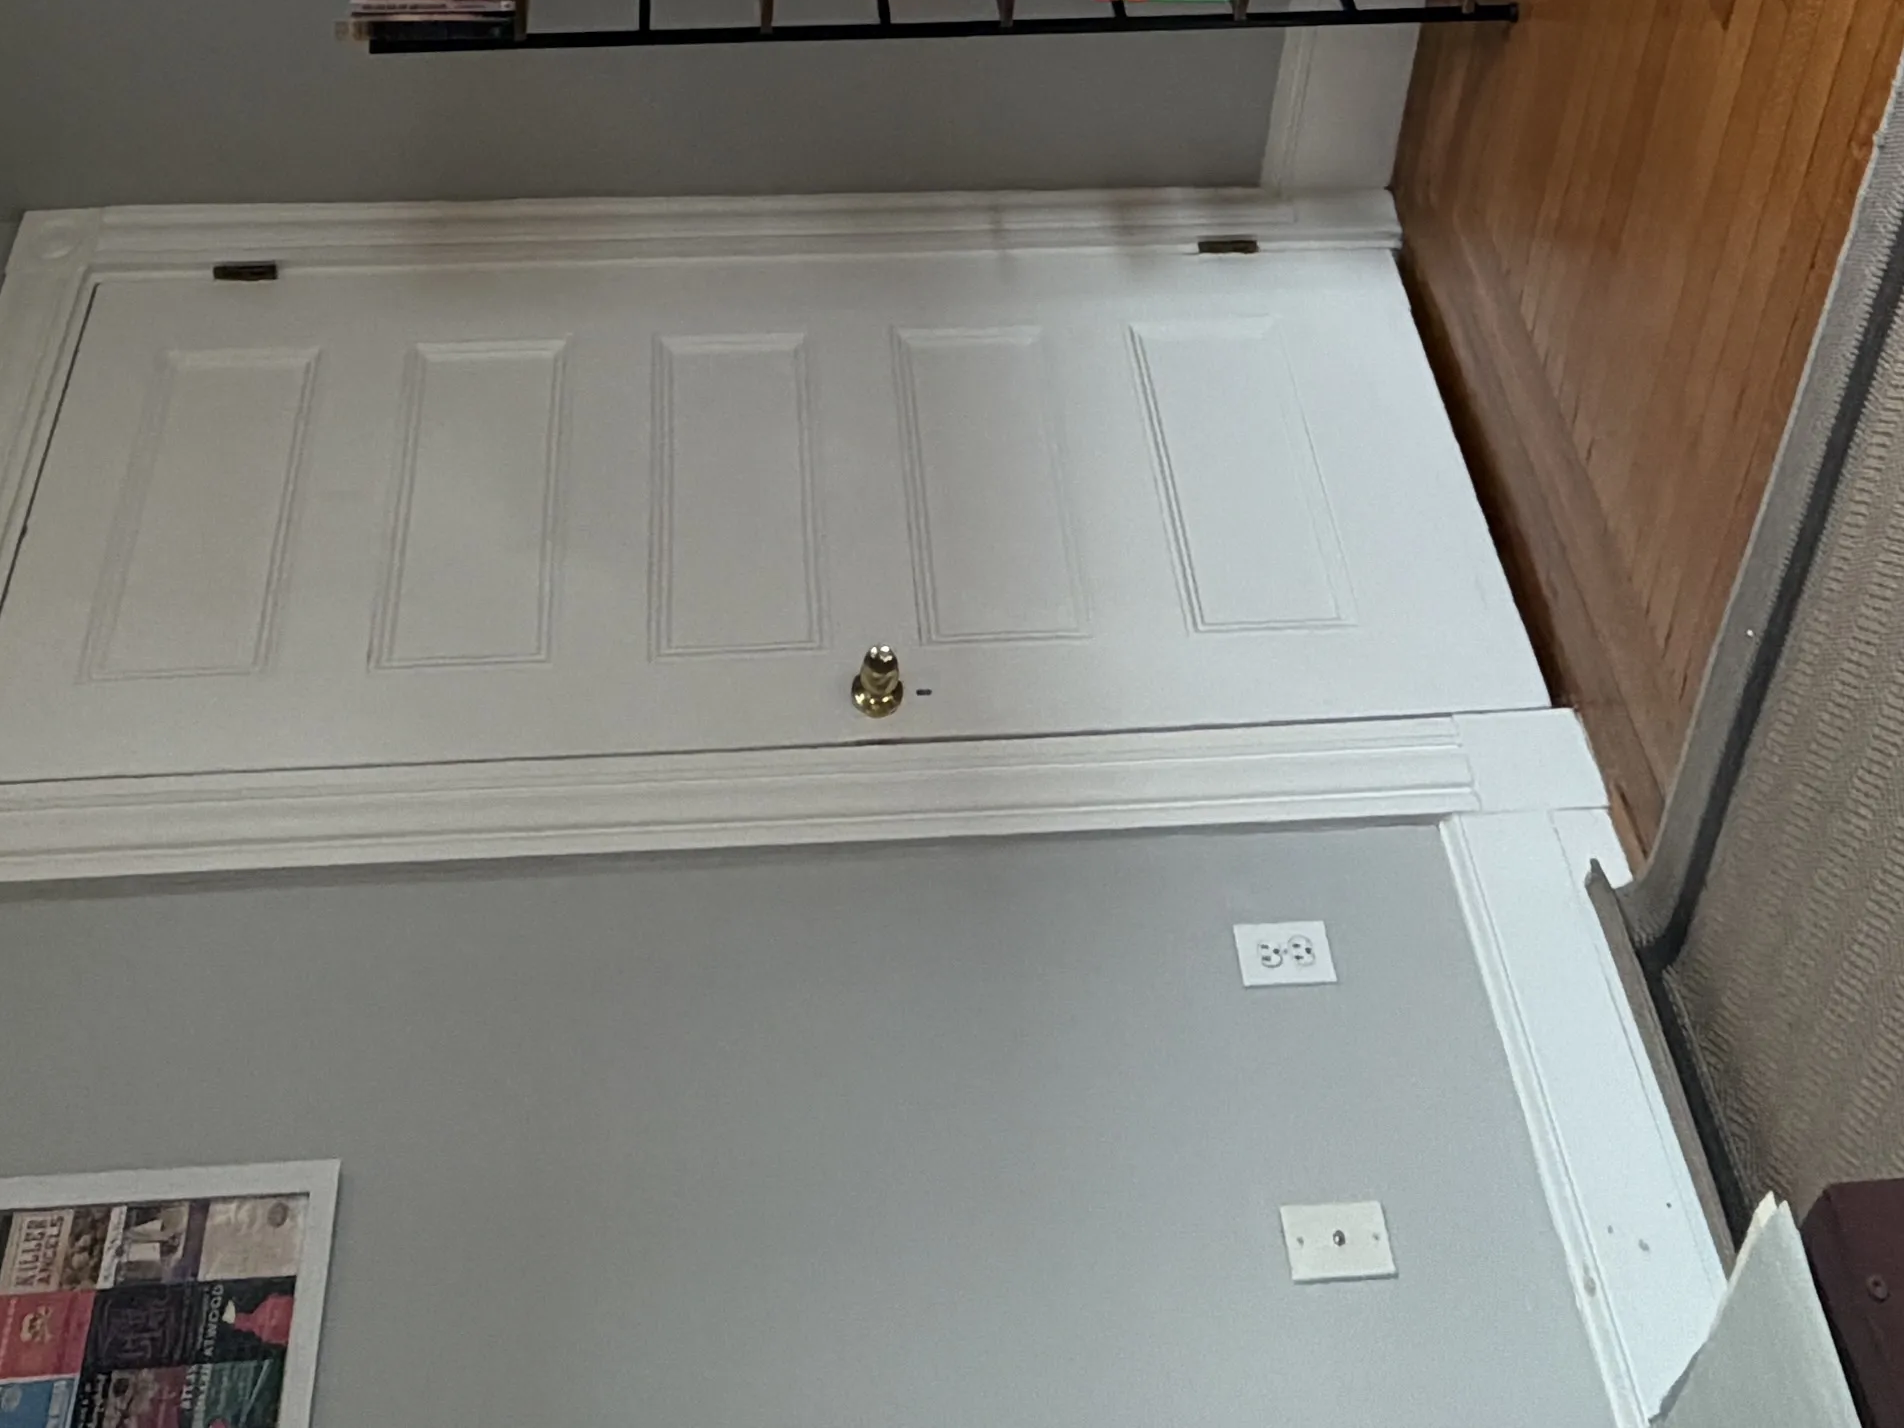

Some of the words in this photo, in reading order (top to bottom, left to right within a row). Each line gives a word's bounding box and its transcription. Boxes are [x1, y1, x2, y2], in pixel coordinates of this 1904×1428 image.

[13, 1218, 50, 1290] KILLER
[35, 1214, 67, 1286] ANGELS
[203, 1281, 225, 1356] ATWOOD
